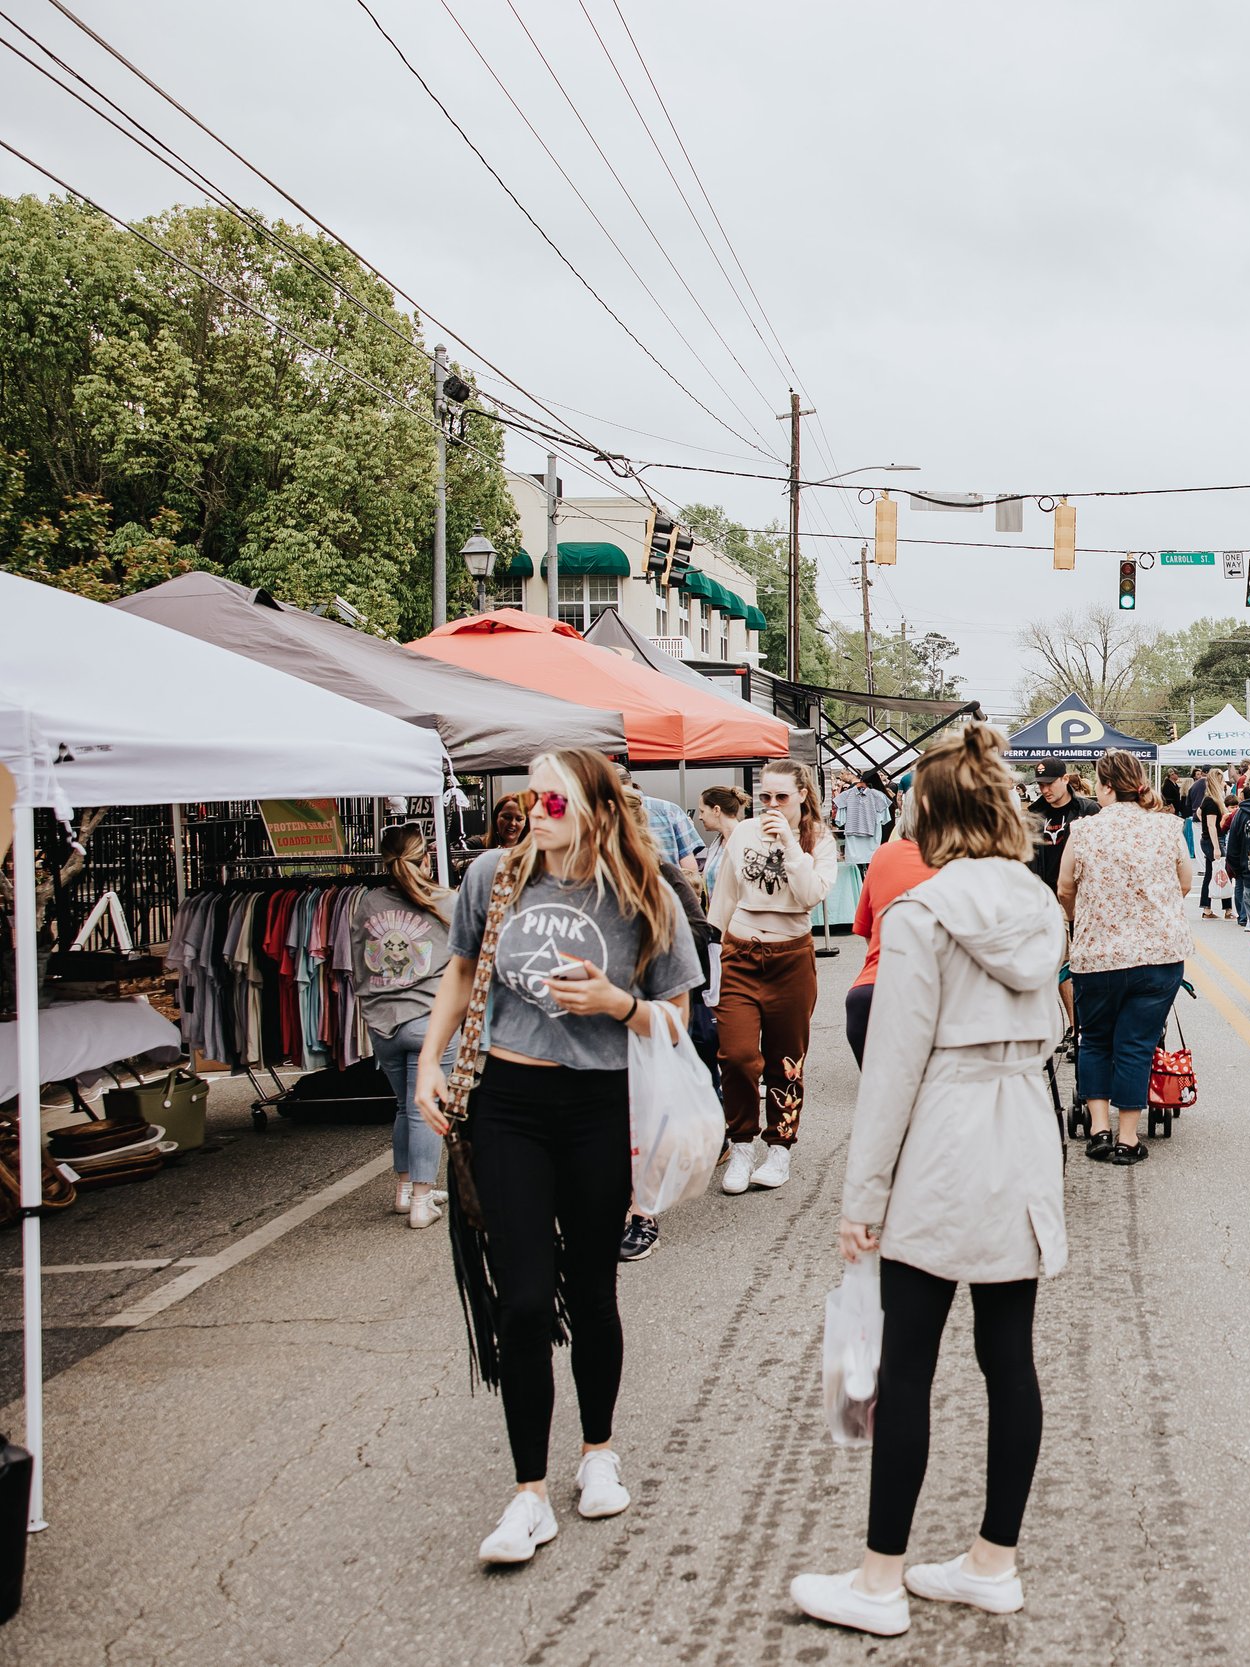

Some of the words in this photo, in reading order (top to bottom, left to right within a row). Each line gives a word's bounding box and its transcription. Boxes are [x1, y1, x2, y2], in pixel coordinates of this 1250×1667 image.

[1165, 555, 1194, 564] CARROLL
[1200, 555, 1211, 563] ST.
[1187, 749, 1237, 757] WELCOME
[267, 821, 307, 833] PROTEIN
[276, 835, 311, 848] LOADED
[313, 834, 332, 845] TEAS
[522, 912, 588, 942] PINK
[506, 970, 550, 999] FLO
